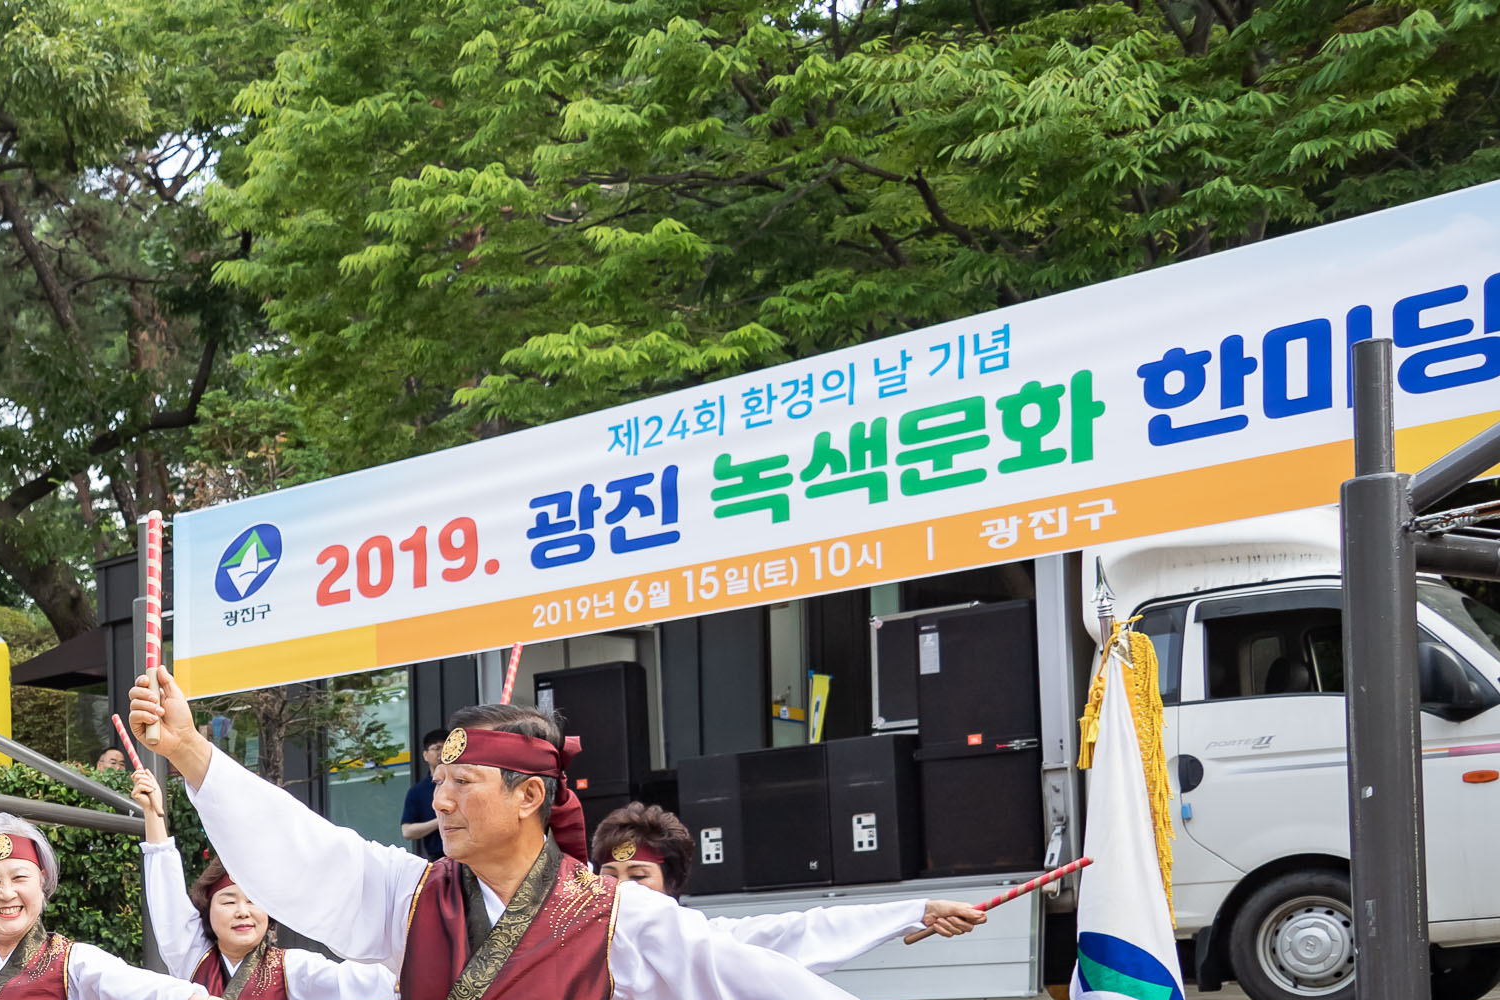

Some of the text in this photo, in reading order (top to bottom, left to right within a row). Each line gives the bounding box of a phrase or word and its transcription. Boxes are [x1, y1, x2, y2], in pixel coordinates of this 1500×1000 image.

[607, 323, 1011, 457] 제24회 환경의 날 기념
[316, 517, 500, 606] 2019.
[526, 465, 681, 570] 광진
[710, 370, 1106, 524] 녹색문화
[222, 603, 272, 627] 광진구
[532, 498, 1118, 628] 2019년 6월 15일(토) 10시 광진구
